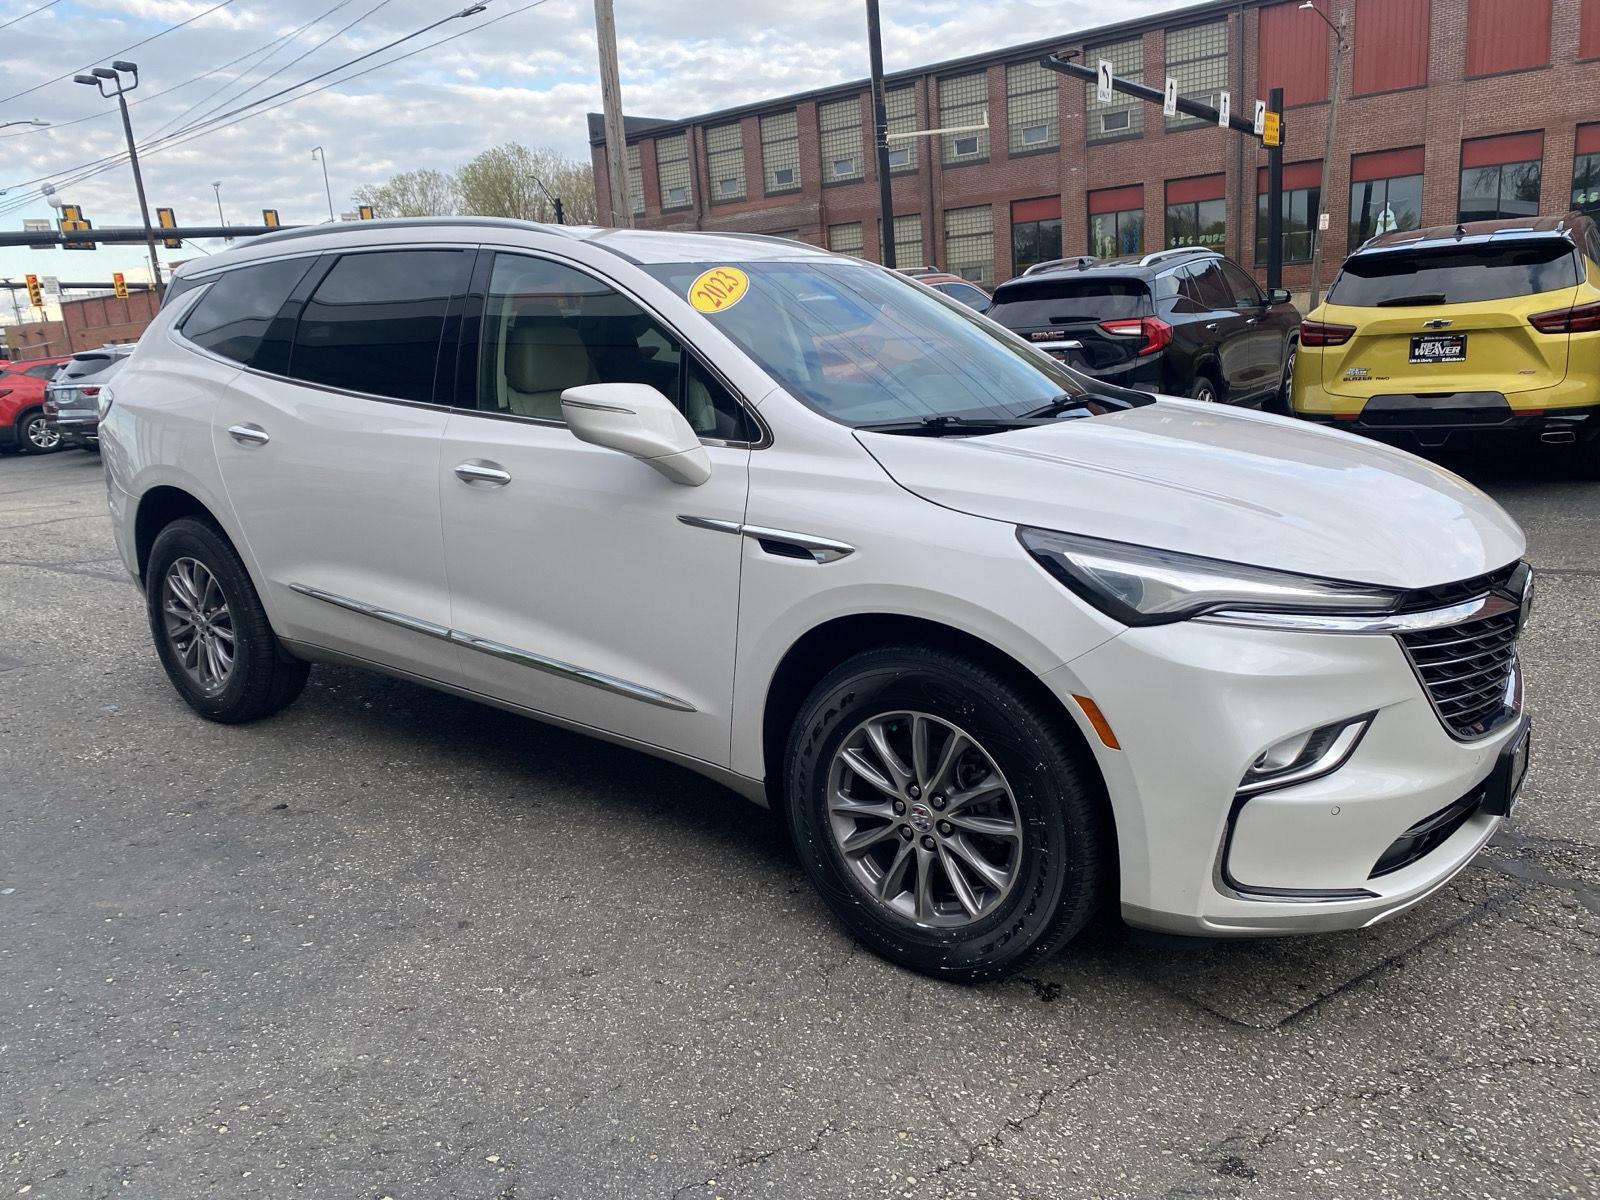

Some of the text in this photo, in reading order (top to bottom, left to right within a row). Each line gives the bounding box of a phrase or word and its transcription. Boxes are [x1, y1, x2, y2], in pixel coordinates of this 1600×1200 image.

[697, 271, 739, 308] 2023
[1031, 331, 1065, 340] GMC
[1420, 341, 1442, 350] RICK
[1414, 346, 1461, 356] WEAVER
